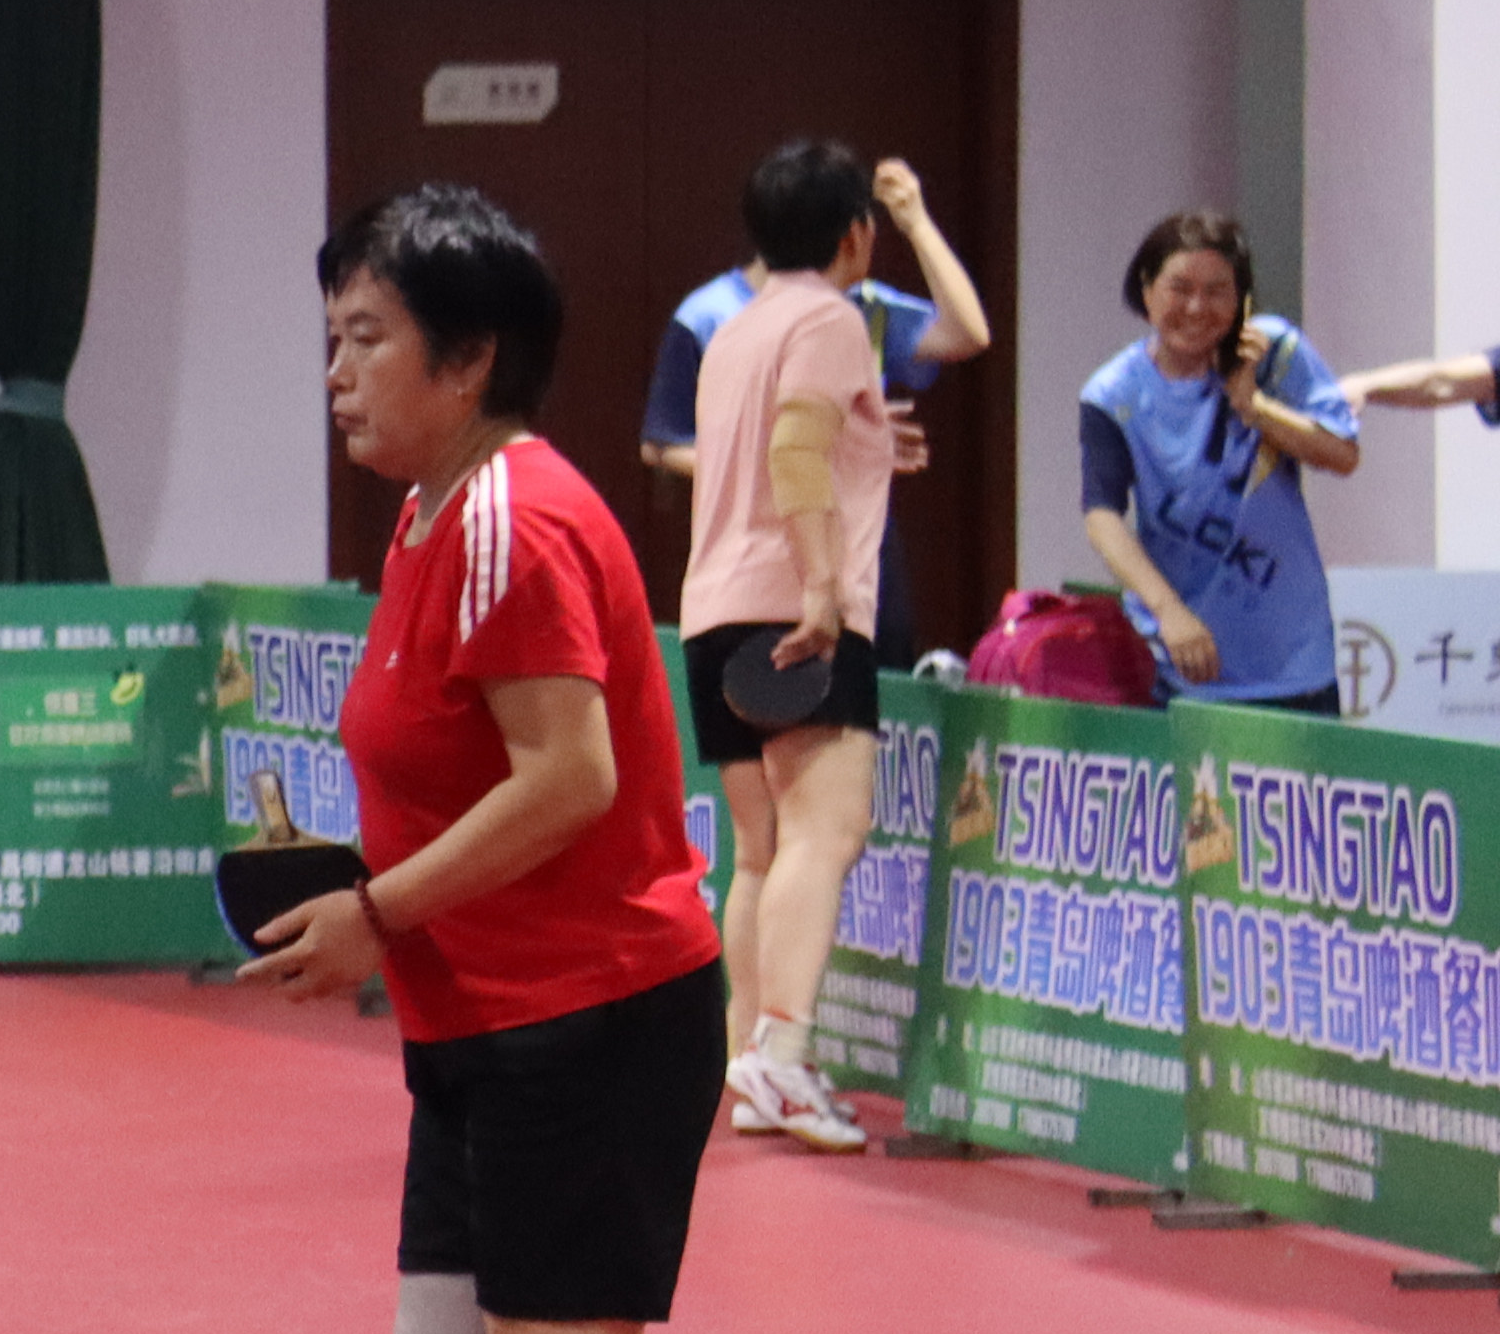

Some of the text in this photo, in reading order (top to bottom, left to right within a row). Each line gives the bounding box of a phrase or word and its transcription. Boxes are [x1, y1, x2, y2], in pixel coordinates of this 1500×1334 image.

[247, 625, 367, 732] TSINGT
[994, 744, 1182, 887] TSINGTAO
[1228, 762, 1461, 927] TSINGTAO
